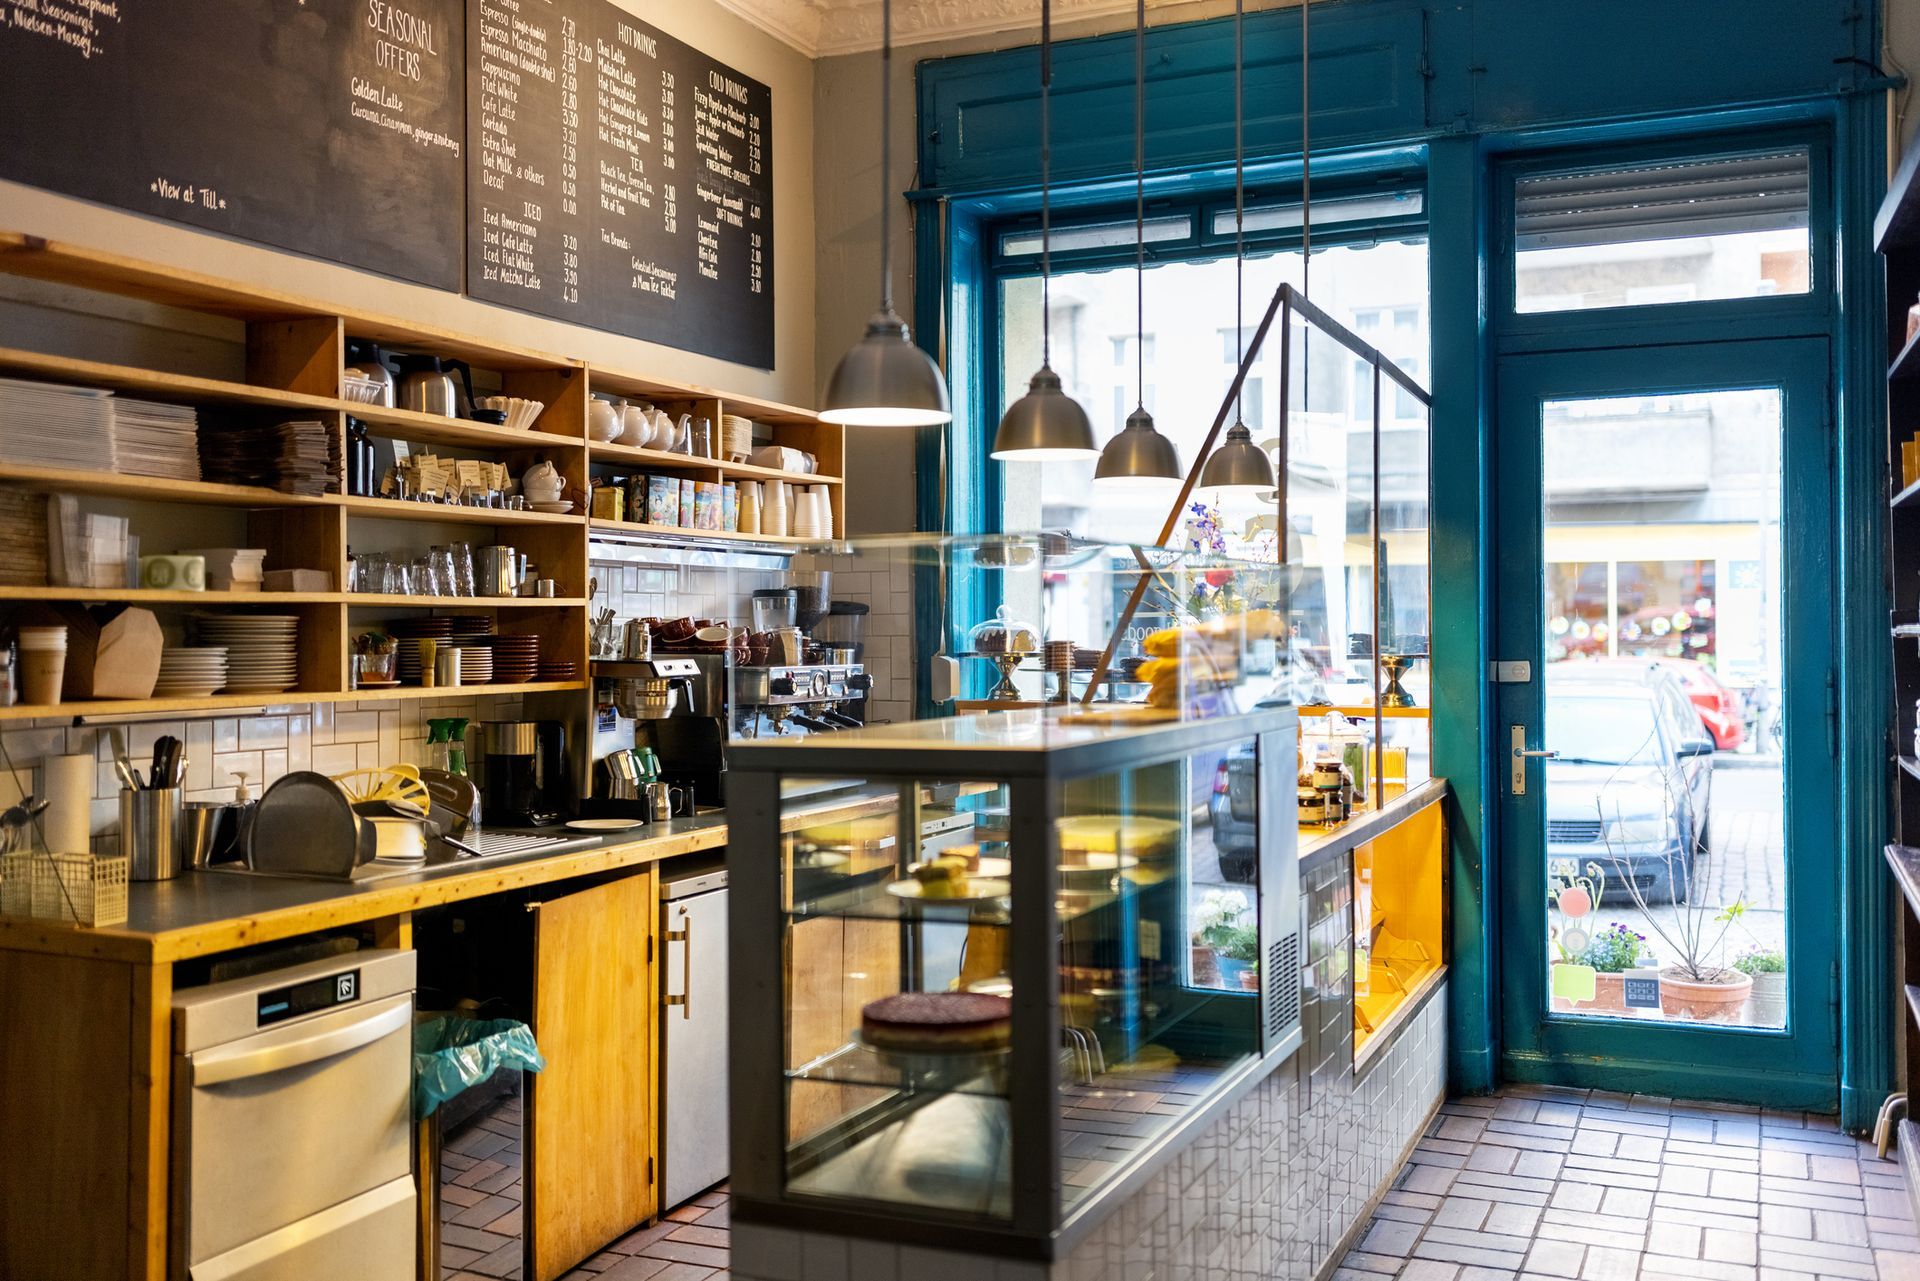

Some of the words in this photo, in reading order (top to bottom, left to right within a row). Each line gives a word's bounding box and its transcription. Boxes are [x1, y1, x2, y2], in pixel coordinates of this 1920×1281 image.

[368, 0, 437, 55] SEASONAL
[480, 0, 509, 26] Espresso
[480, 19, 509, 44] Espresso
[512, 30, 547, 62] Macchiato
[481, 36, 519, 66] Americano
[597, 38, 610, 59] Chai
[611, 44, 627, 66] Latte
[618, 22, 633, 47] HOT
[634, 29, 657, 59] DRINKS
[376, 40, 420, 81] OFFERS
[481, 55, 521, 86] Cappuccino
[598, 56, 621, 81] Matcha
[621, 67, 637, 89] Latte
[351, 77, 380, 104] Golden
[381, 86, 403, 112] Latte
[482, 75, 497, 95] Flat
[498, 80, 518, 104] White
[563, 109, 579, 129] 3.30
[598, 73, 609, 92] Hot
[610, 79, 637, 105] Chocolate
[695, 86, 708, 109] Fizzy
[709, 93, 723, 116] Apple
[710, 70, 725, 93] COLD
[725, 78, 748, 105] DRINKS
[482, 93, 497, 114] Cafe
[499, 99, 516, 121] Latte
[563, 127, 577, 146] 3.20
[598, 91, 610, 109] Hot
[610, 97, 636, 121] Chocolate
[637, 108, 649, 127] Kids
[598, 107, 610, 126] Hot
[610, 115, 627, 137] Ginger
[634, 124, 651, 144] Lemon
[709, 113, 722, 129] Apple
[482, 112, 508, 136] Cortado
[563, 144, 577, 163] 2.50
[599, 126, 610, 143] Hot
[610, 132, 626, 150] Fresh
[626, 138, 639, 156] Mint
[719, 145, 733, 163] Water
[482, 131, 501, 152] Extra
[501, 137, 517, 159] Shot
[563, 163, 577, 181] 0.50
[631, 156, 644, 174] TEA
[483, 151, 496, 170] Oat
[497, 155, 513, 176] Milk
[516, 166, 523, 180] &
[524, 165, 545, 186] others
[563, 180, 577, 198] 0.50
[600, 160, 617, 180] Black
[629, 172, 644, 190] Green
[184, 185, 195, 204] at
[484, 170, 505, 191] Decaf
[563, 198, 577, 216] 0.00
[601, 177, 618, 197] Herbal
[618, 188, 627, 201] and
[639, 191, 651, 209] Teas
[601, 194, 610, 211] Pot
[610, 199, 616, 213] of
[616, 200, 626, 216] Tea
[524, 201, 542, 222] ICED
[483, 207, 499, 227] Iced
[501, 213, 537, 239] Americano
[563, 235, 578, 251] 3.20
[601, 228, 610, 244] Tea
[483, 227, 500, 246] Iced
[502, 232, 516, 250] Cafe
[516, 236, 534, 255] Latte
[563, 252, 578, 269] 3.80
[483, 246, 500, 264] Iced
[502, 249, 516, 268] Flat
[516, 253, 534, 273] White
[483, 265, 498, 281] Iced
[501, 268, 524, 286] Matcha
[525, 273, 541, 290] Latte
[563, 287, 578, 304] 4.10
